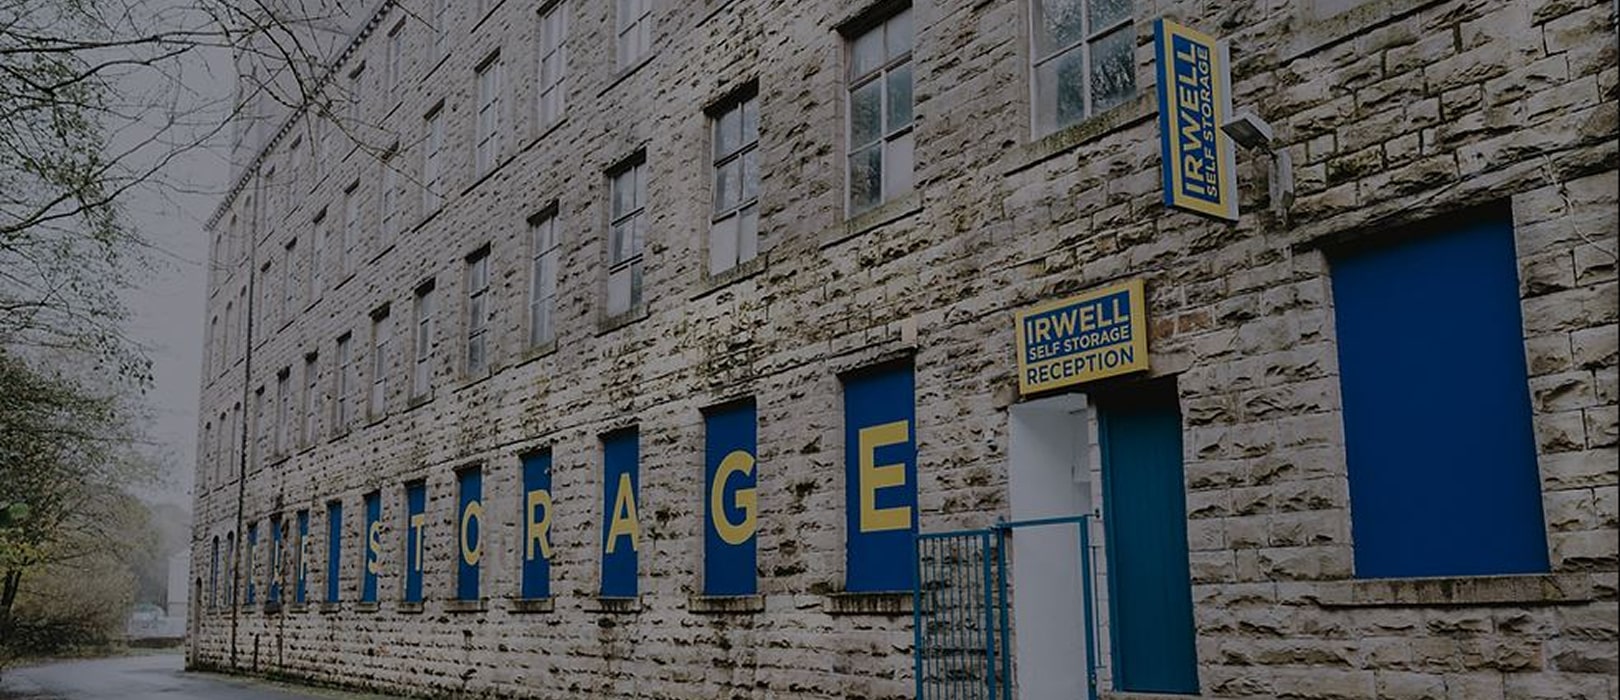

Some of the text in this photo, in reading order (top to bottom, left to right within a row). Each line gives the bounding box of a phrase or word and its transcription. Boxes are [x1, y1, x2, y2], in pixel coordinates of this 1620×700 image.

[1176, 43, 1206, 196] IRWELL
[1196, 47, 1218, 198] SELF STORAGE
[1026, 298, 1130, 345] IRWELL
[1028, 324, 1130, 361] SELF STORAGE
[1026, 345, 1134, 385] RECEPTION
